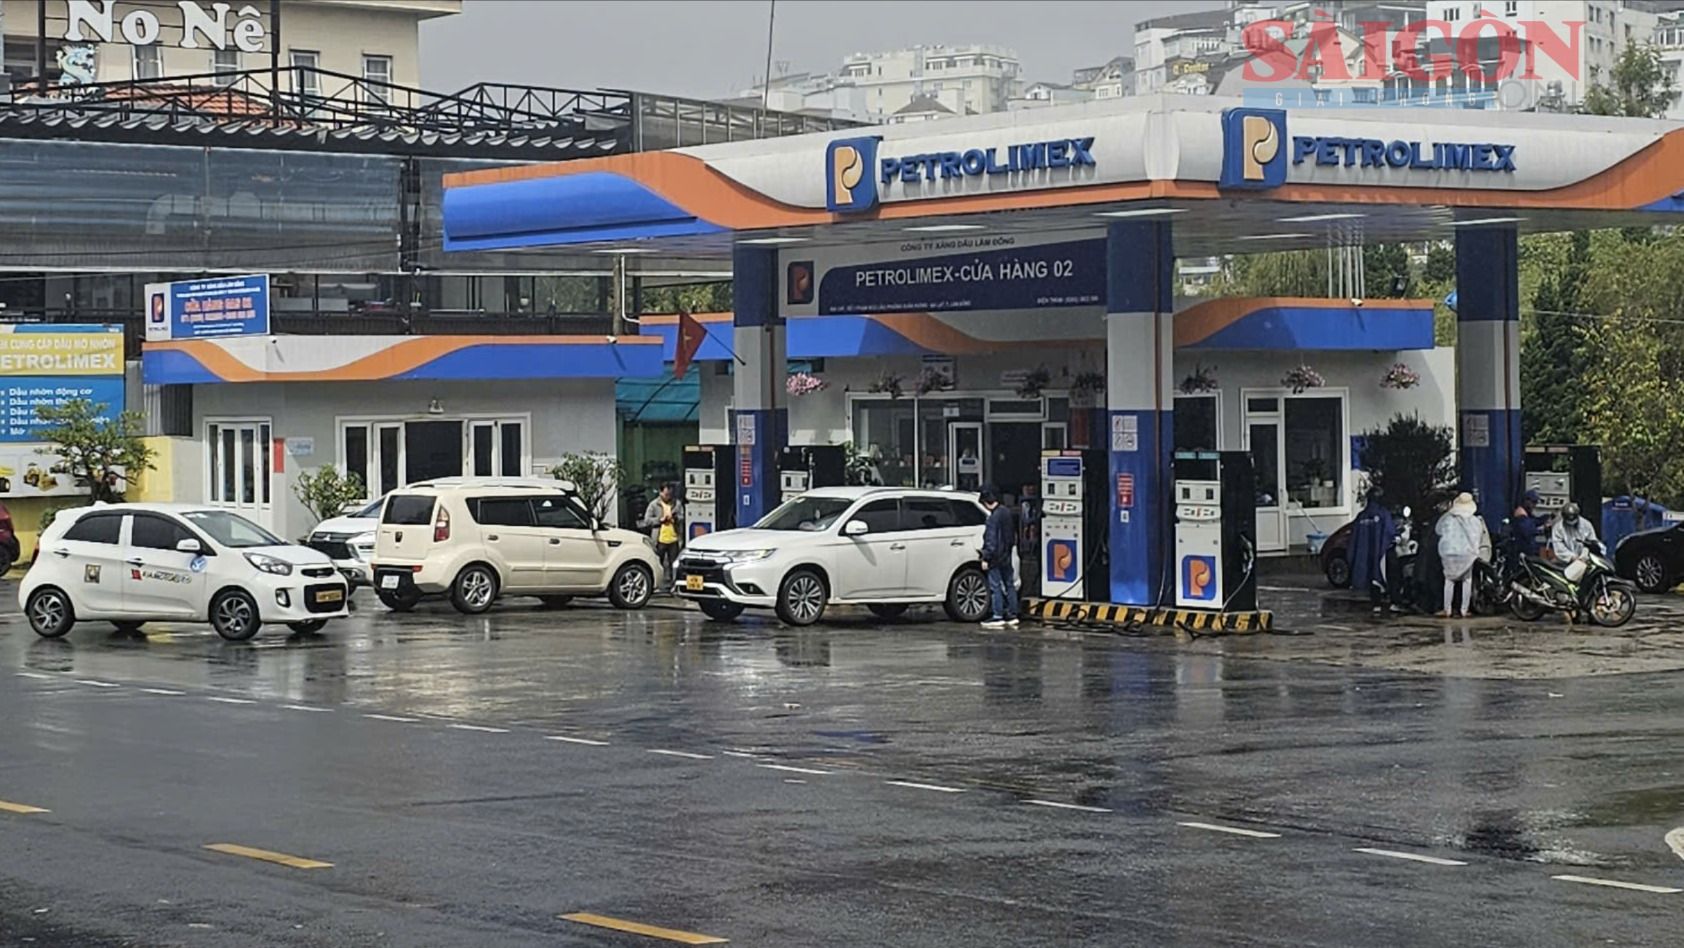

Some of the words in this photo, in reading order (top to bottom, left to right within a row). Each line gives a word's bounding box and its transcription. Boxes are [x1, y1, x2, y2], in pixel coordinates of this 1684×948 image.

[65, 0, 160, 46] No
[178, 0, 265, 52] Nê
[881, 137, 1096, 184] PETROLIMEX
[1292, 136, 1517, 172] PETROLIMEX
[855, 258, 994, 287] PETROLIMEX-CỬA
[999, 258, 1048, 280] HÀNG
[1053, 259, 1073, 277] 02
[0, 354, 116, 369] ETROLIMEX
[9, 387, 28, 396] Dầu
[9, 397, 28, 406] Dầu
[9, 407, 28, 416] Dầu
[9, 417, 28, 425] Dầu
